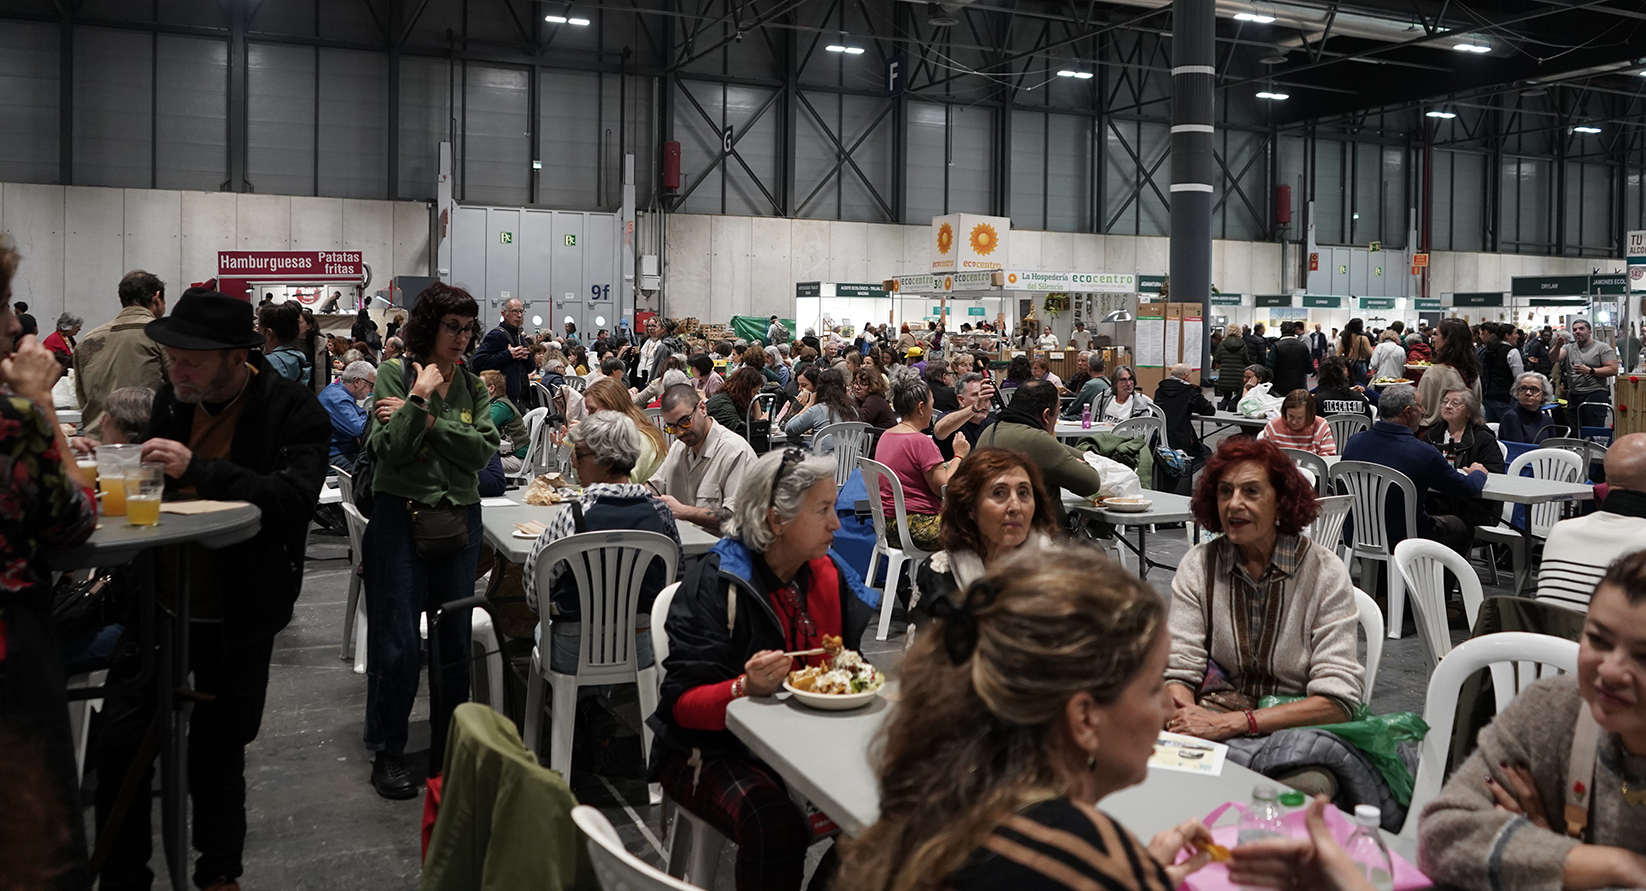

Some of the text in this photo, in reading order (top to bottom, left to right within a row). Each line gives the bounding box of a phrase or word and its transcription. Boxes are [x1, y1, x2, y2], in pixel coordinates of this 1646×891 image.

[889, 61, 899, 92] F
[723, 130, 732, 153] G
[1631, 235, 1643, 246] TU
[220, 254, 312, 272] Hamburguesas
[318, 252, 360, 263] Patatas
[325, 263, 355, 274] fritas
[963, 260, 1002, 270] ecocentro
[954, 272, 990, 283] ecocentro
[1022, 272, 1068, 283] La Hospedería
[1072, 274, 1133, 284] ecocentro
[1631, 270, 1642, 278] 142
[901, 276, 943, 289] ecocentro 30
[1038, 283, 1064, 291] Silencio
[591, 284, 610, 300] 9f
